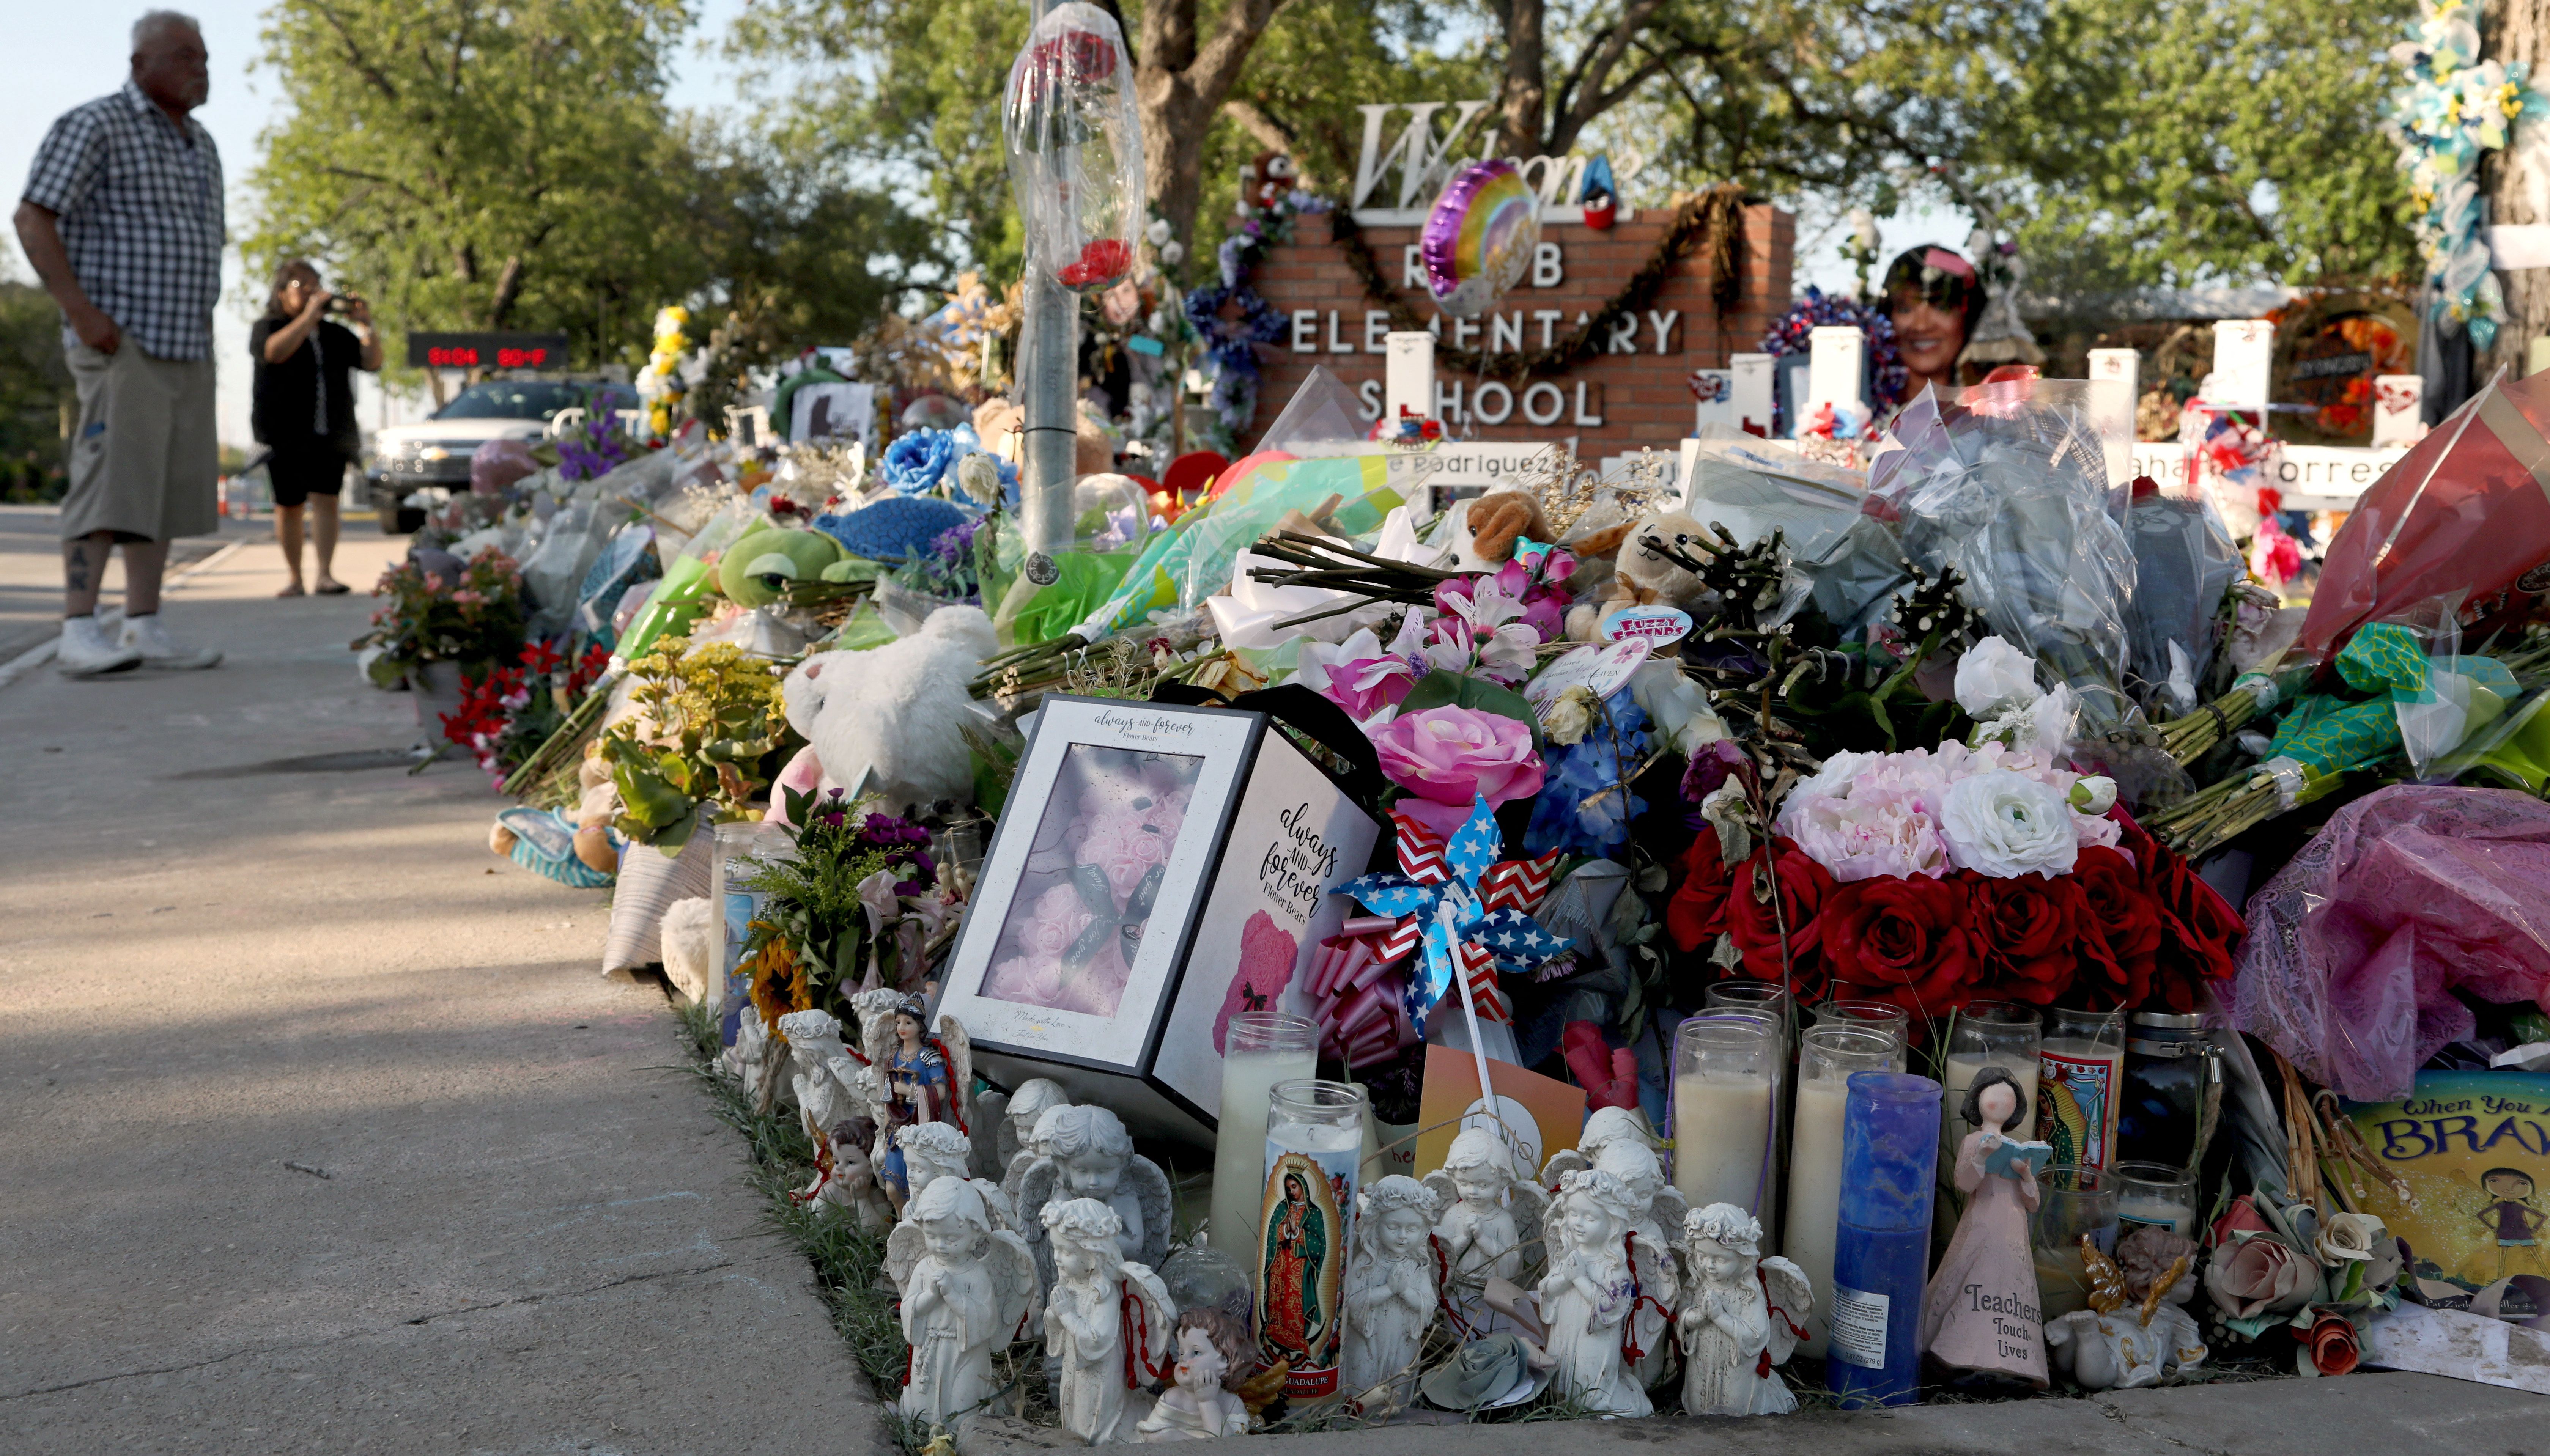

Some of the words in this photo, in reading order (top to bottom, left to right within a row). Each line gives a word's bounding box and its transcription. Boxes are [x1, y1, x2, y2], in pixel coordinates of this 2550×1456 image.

[1404, 242, 1563, 288] RB
[1292, 310, 1679, 354] ELEENTRY
[1359, 380, 1601, 426] SHOOL
[1415, 454, 1547, 477] Rodriguez
[1619, 616, 1680, 631] FUZZY
[1543, 670, 1569, 679] Guardian
[1588, 670, 1620, 679] HEAVEN
[1094, 709, 1135, 733] always
[1153, 717, 1196, 736] forever
[1280, 802, 1338, 878] always
[1260, 841, 1322, 918] forever
[1262, 881, 1286, 908] Flower
[1285, 900, 1306, 926] Bears
[2399, 1099, 2472, 1115] When
[2481, 1095, 2531, 1114] You
[1964, 1284, 2041, 1326] Teachers
[2424, 1299, 2441, 1307] Pat
[2500, 1300, 2519, 1309] iller
[1993, 1317, 2029, 1341] Touch
[1998, 1340, 2028, 1360] Lives
